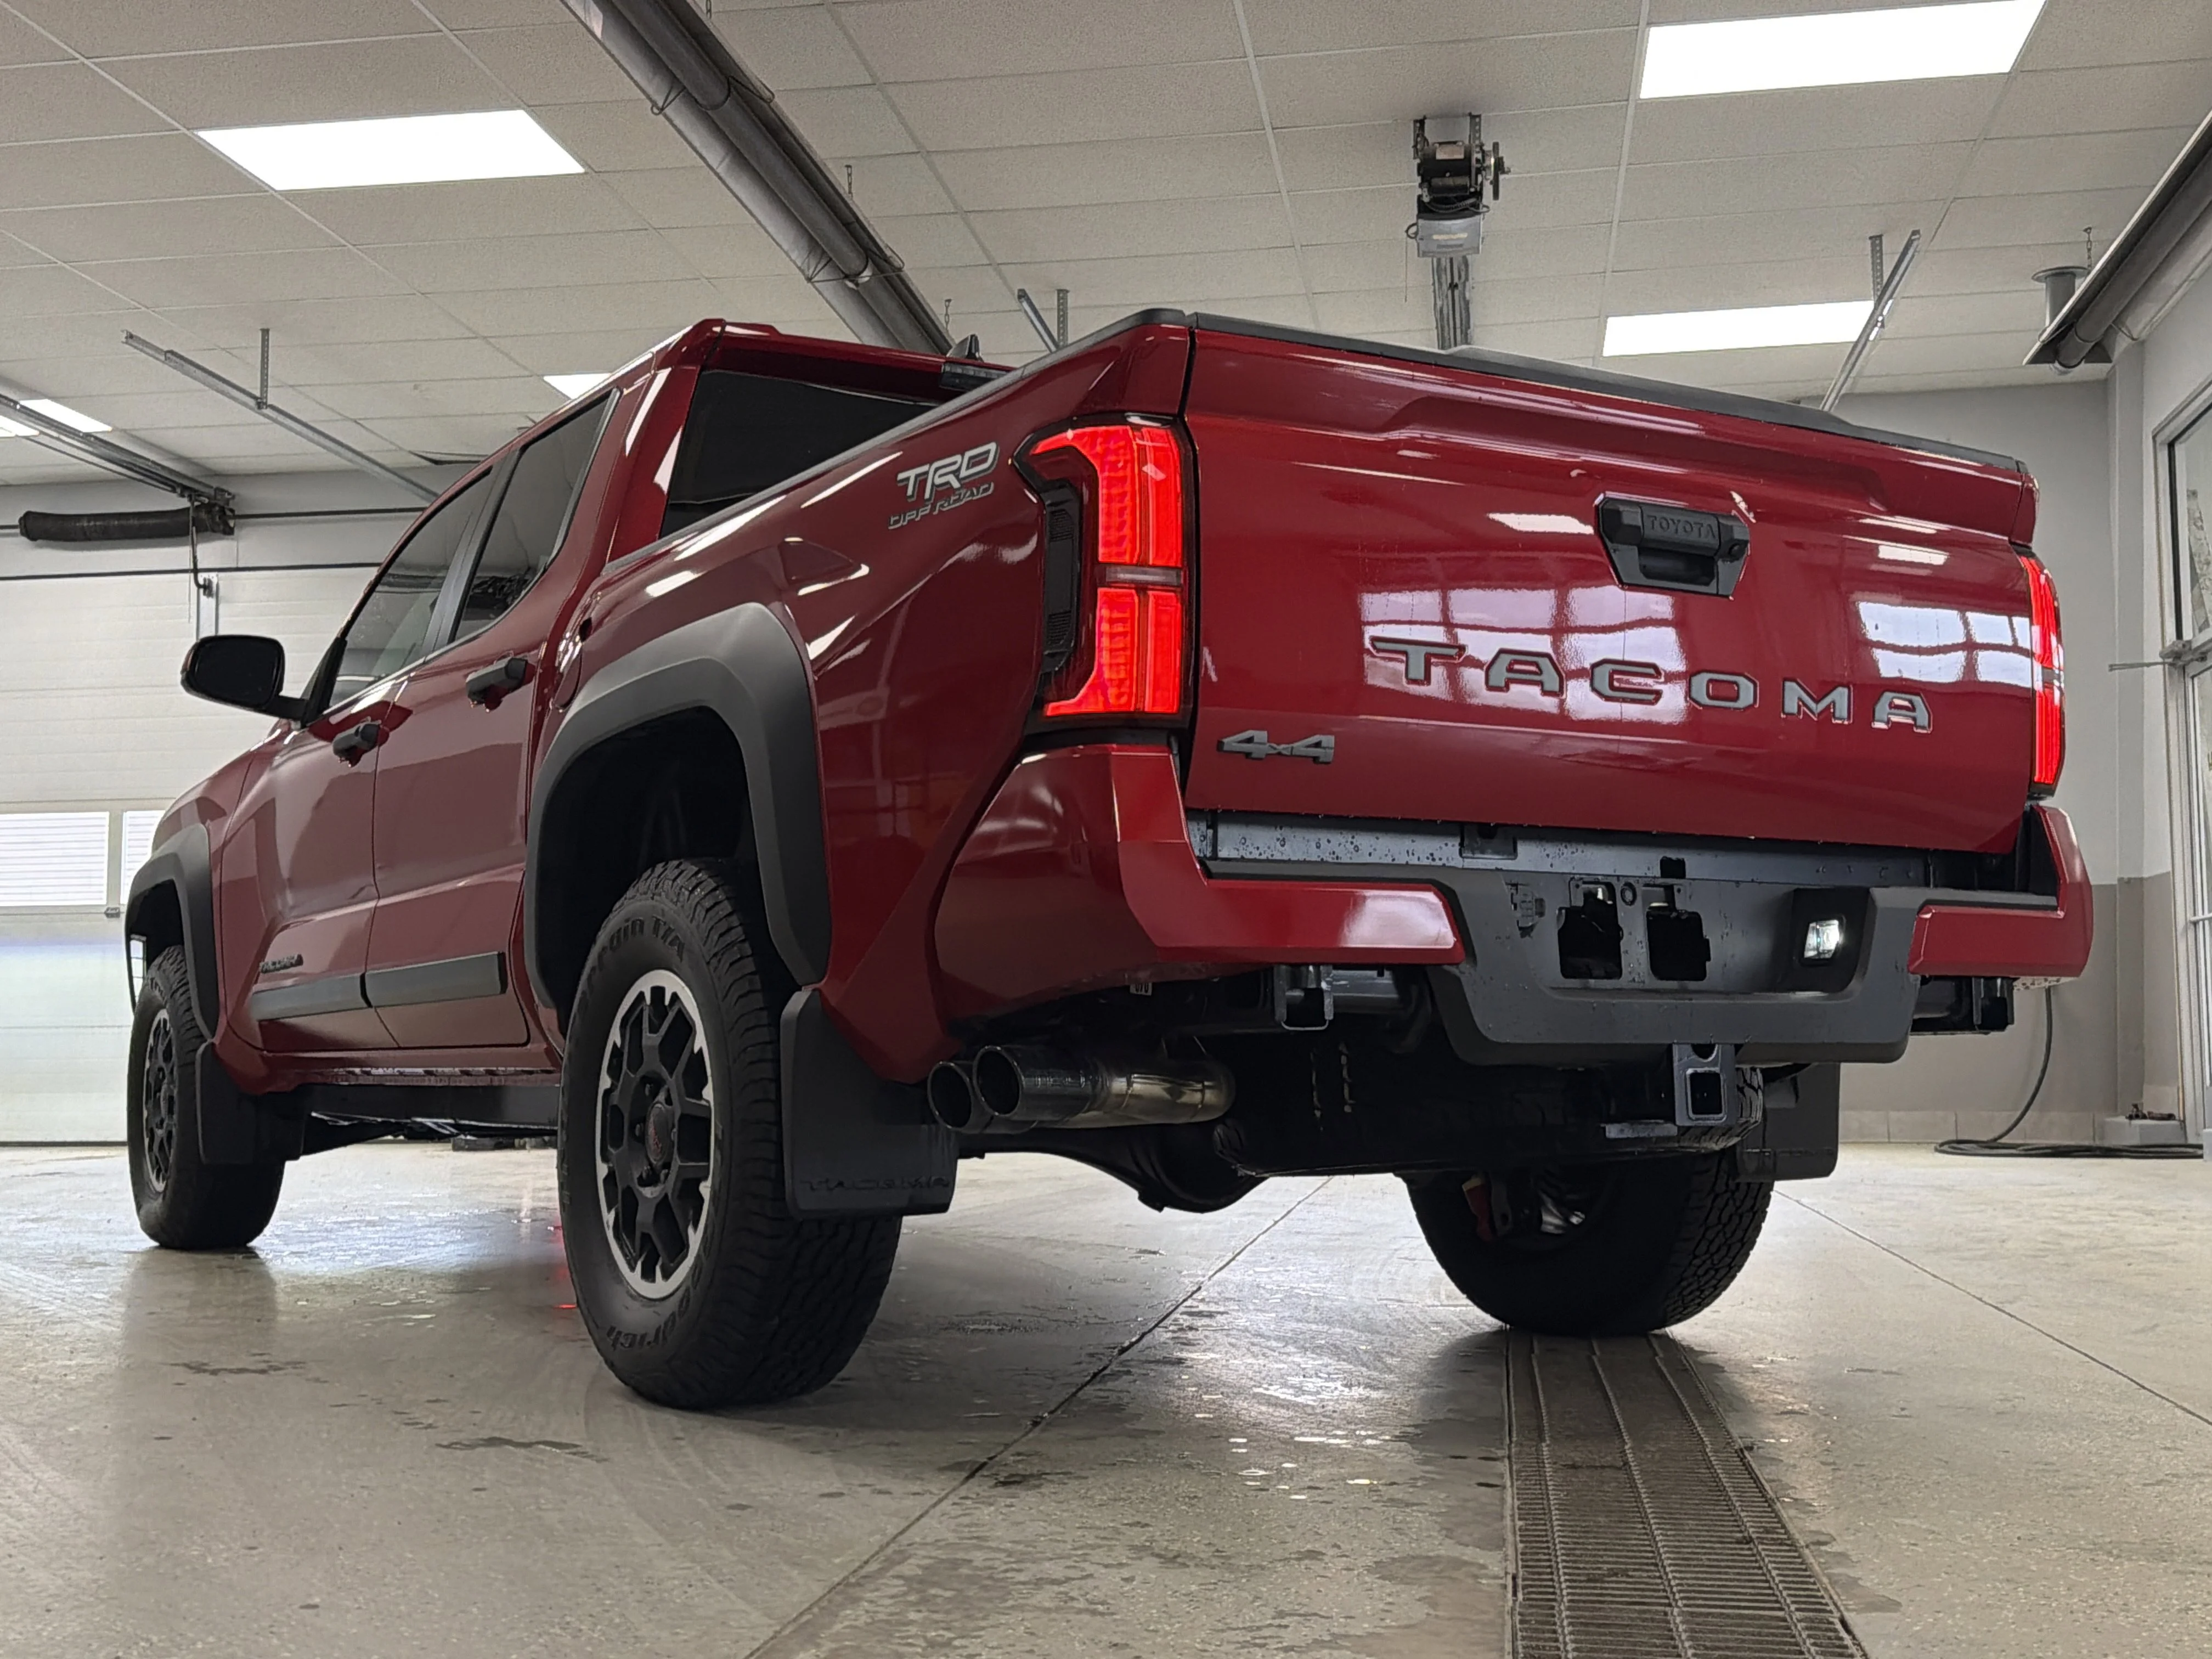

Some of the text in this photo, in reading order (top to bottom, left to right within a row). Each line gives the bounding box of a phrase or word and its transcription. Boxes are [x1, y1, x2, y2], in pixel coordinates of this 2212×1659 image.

[896, 442, 1000, 503] TRD
[888, 481, 995, 531] OFF ROAD
[1646, 514, 1716, 539] TOYOTA
[1369, 635, 1933, 733] TACOMA
